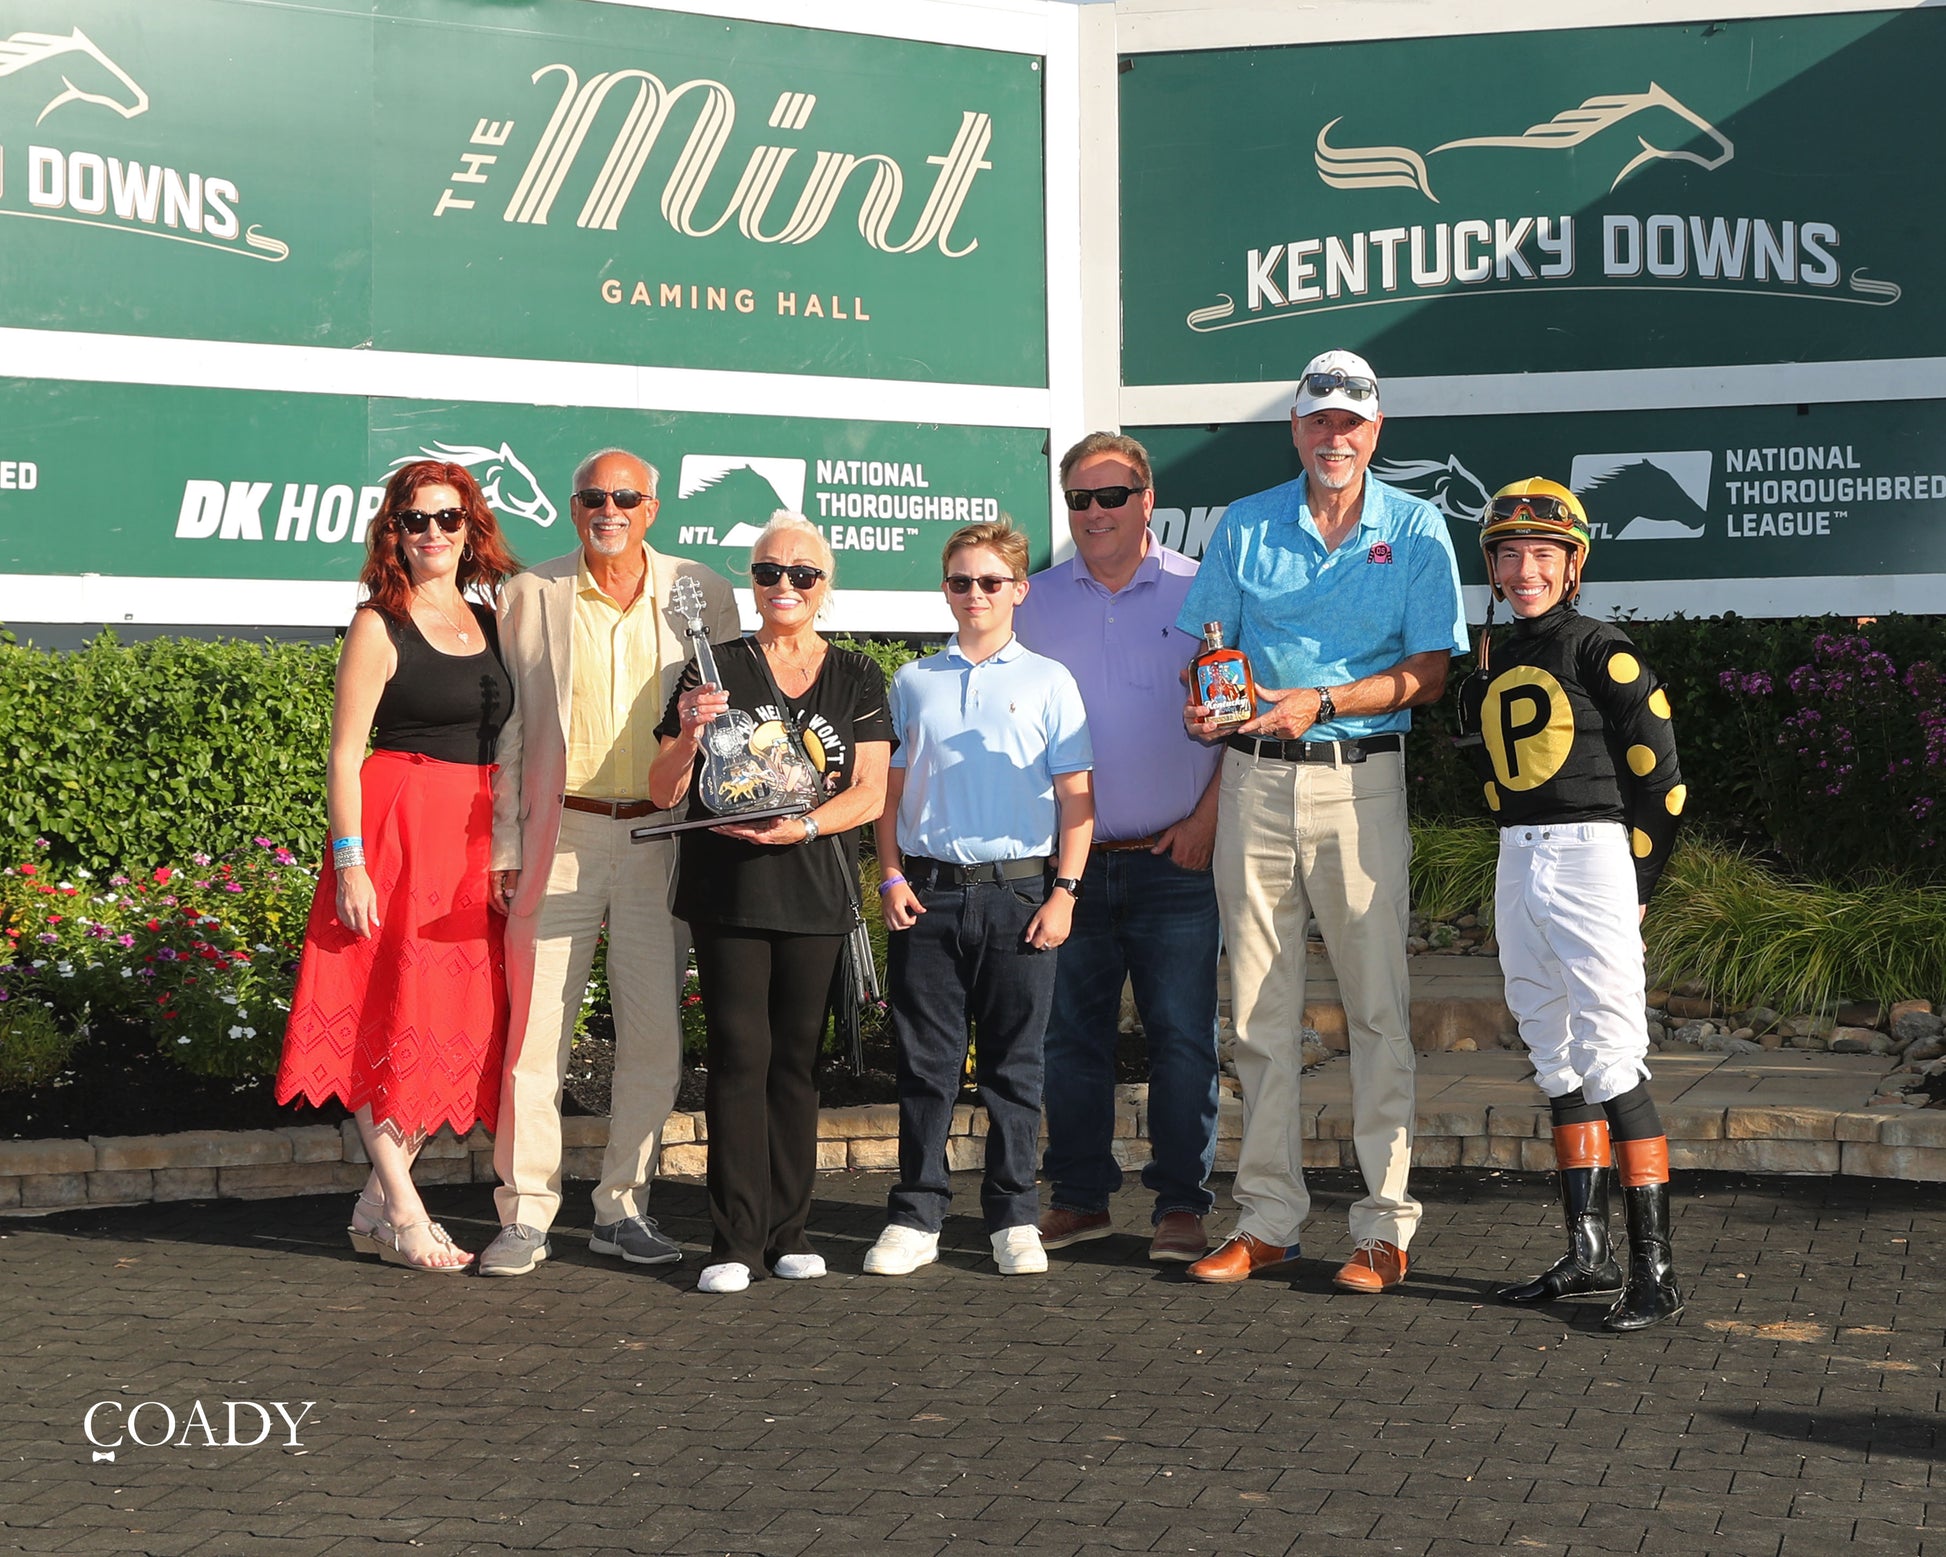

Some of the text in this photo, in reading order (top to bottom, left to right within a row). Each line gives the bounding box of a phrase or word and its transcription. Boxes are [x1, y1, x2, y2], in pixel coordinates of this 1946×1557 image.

[433, 118, 515, 217] THE
[503, 63, 993, 258] Mint
[28, 144, 240, 241] DOWNS
[1246, 213, 1842, 312] KENTUCKY DOWNS
[601, 278, 871, 321] GAMING HALL
[816, 459, 929, 488] NATIONAL
[1726, 445, 1861, 473] NATIONAL
[174, 479, 272, 540] DK
[816, 492, 999, 522] THOROUGHBRED
[1725, 474, 1946, 505] THOROUGHBRED
[678, 526, 719, 545] NTL
[1588, 522, 1613, 540] TL
[808, 713, 846, 765] WON'T
[1500, 683, 1551, 779] P
